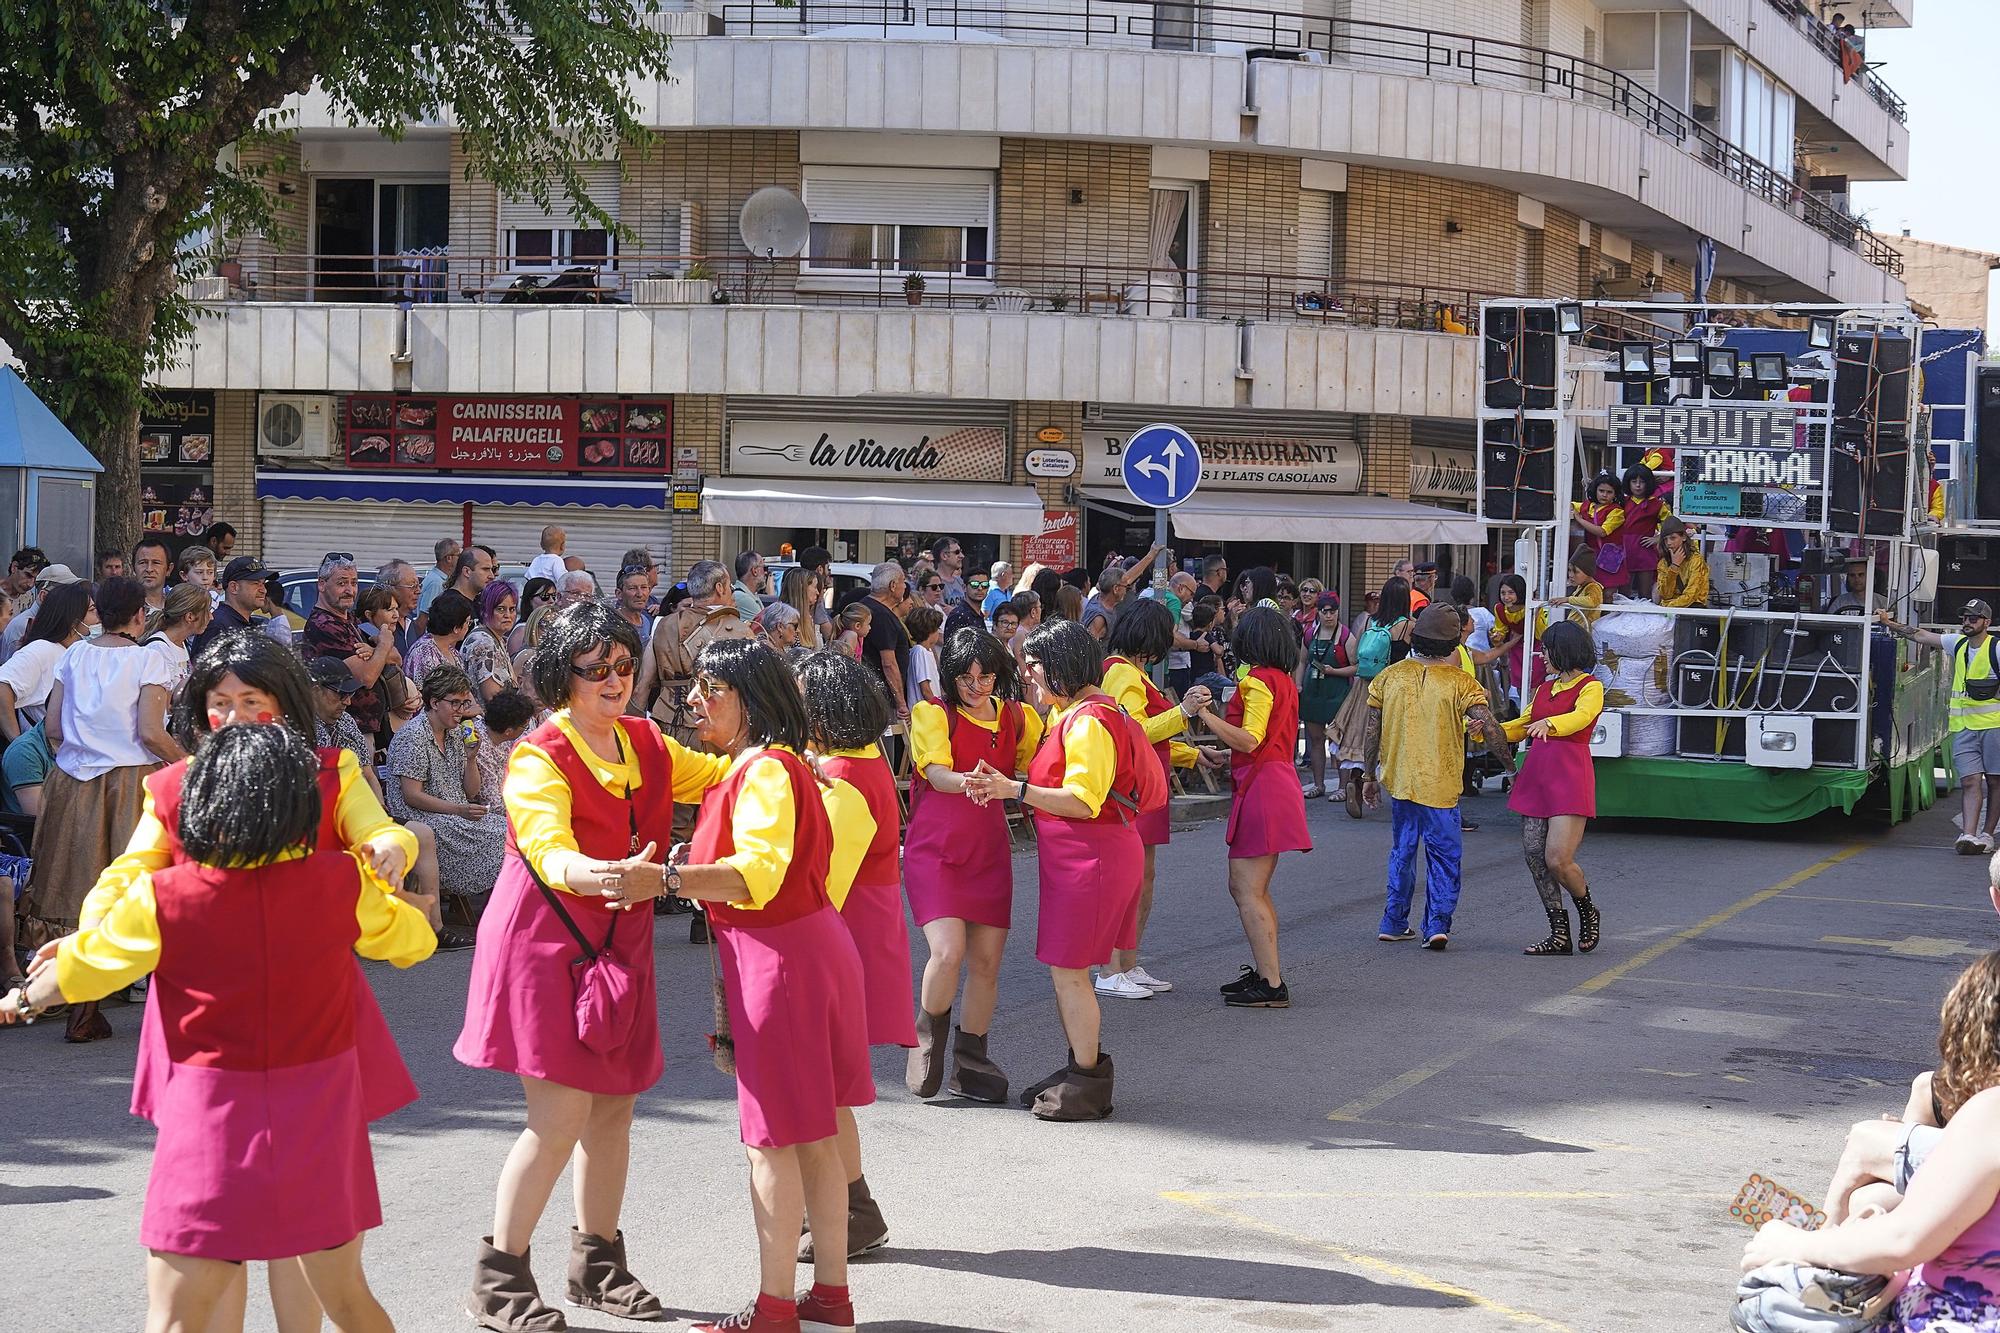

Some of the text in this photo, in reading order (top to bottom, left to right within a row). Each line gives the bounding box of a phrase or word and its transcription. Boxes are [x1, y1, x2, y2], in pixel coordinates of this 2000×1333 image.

[452, 403, 563, 420] CARNISSERIA
[452, 426, 563, 444] PALAFRUGELL
[1609, 407, 1794, 447] PERDUTS
[508, 448, 541, 461] مجزرة
[809, 433, 947, 471] la vianda
[1199, 441, 1338, 463] ESTAURANT
[1212, 470, 1219, 480] I
[1221, 470, 1265, 481] PLATS
[1267, 472, 1338, 484] CASOLANS
[1441, 456, 1478, 495] viand
[1044, 512, 1076, 530] ianda
